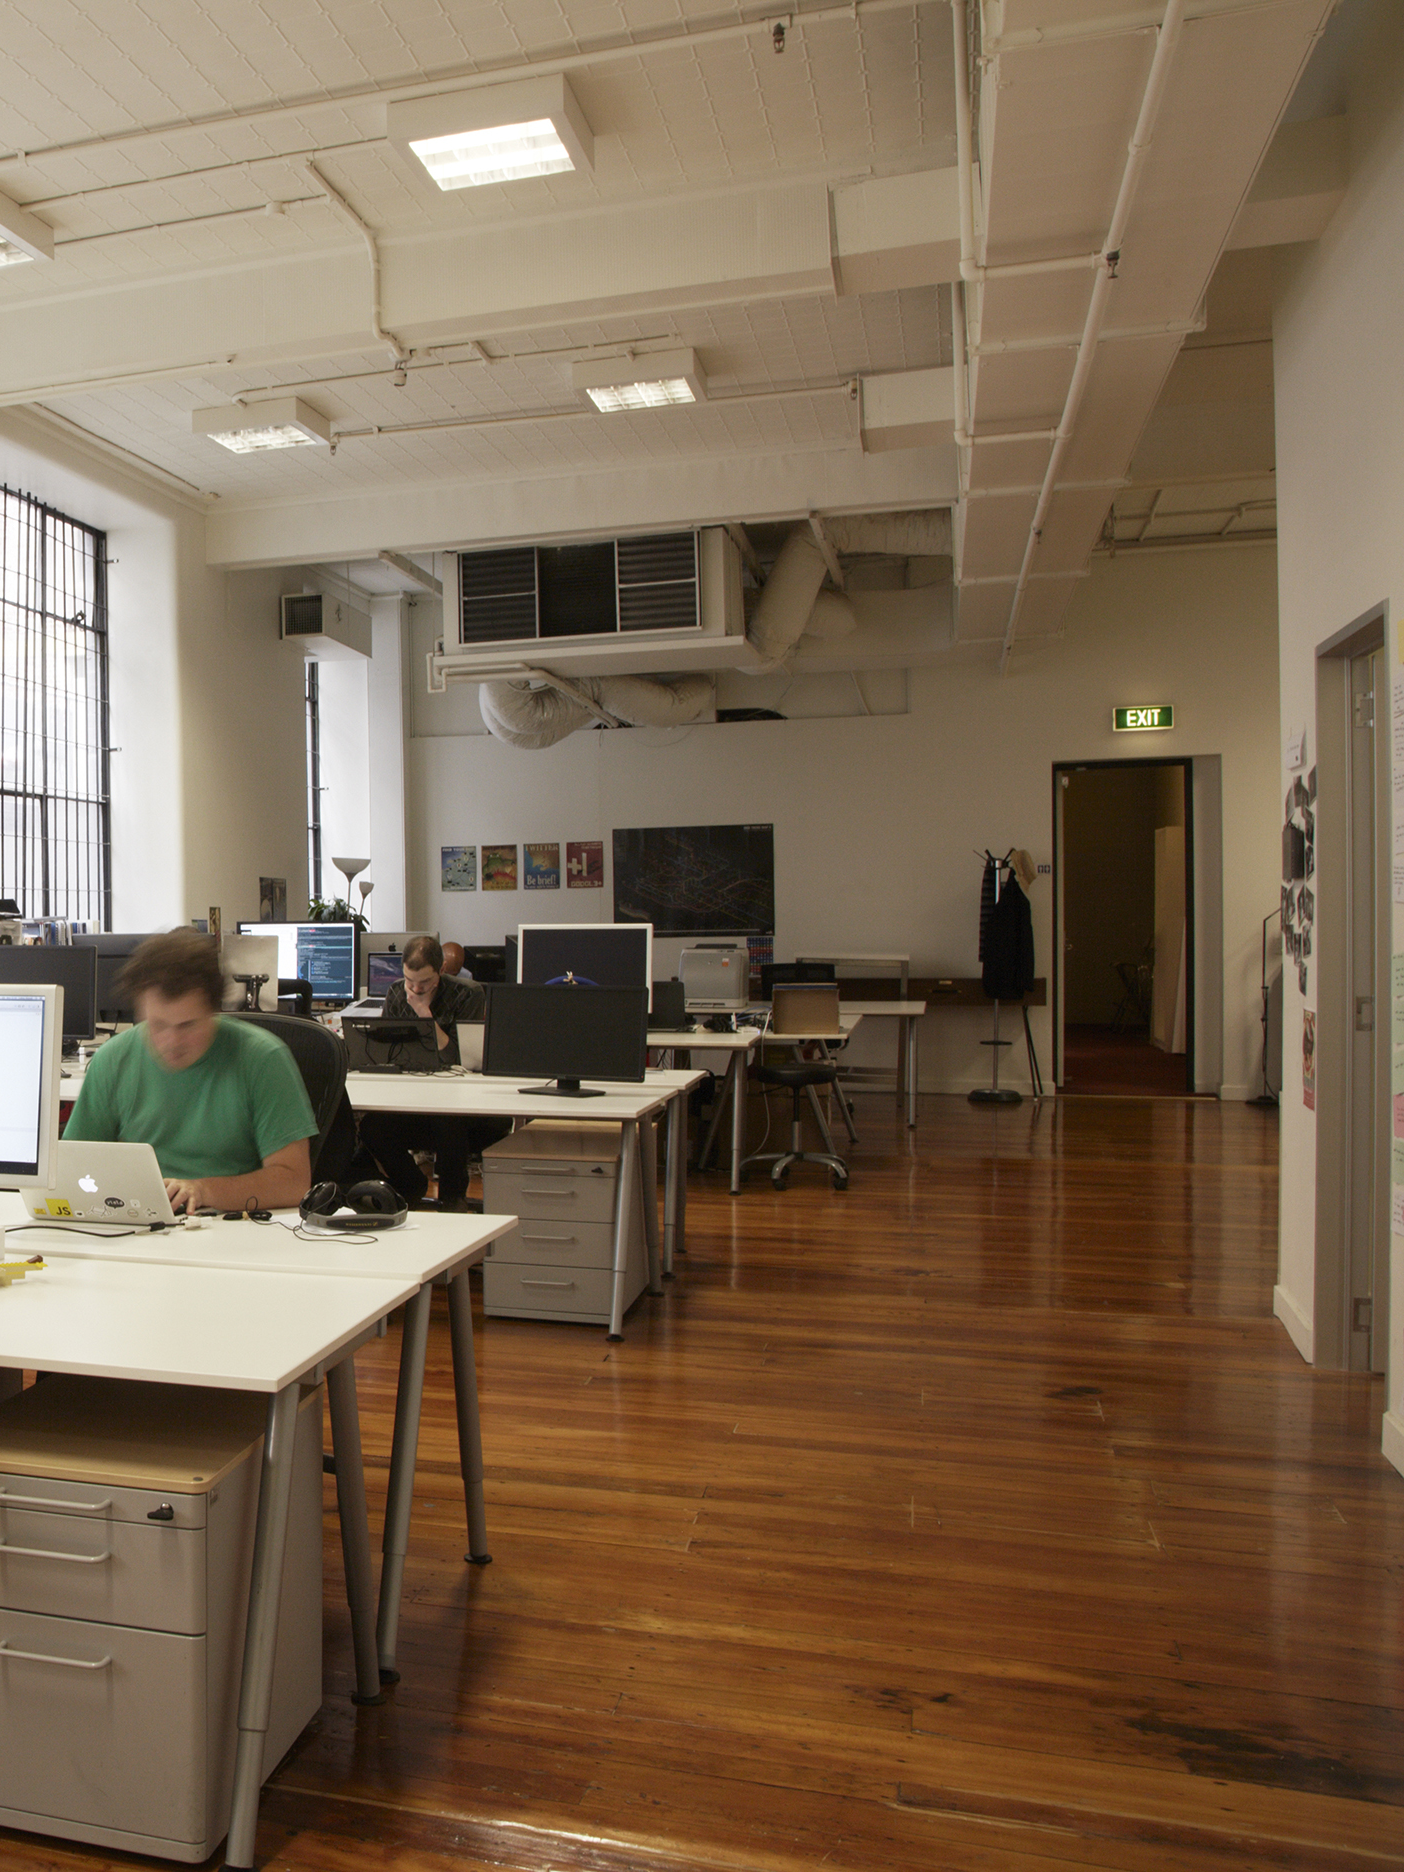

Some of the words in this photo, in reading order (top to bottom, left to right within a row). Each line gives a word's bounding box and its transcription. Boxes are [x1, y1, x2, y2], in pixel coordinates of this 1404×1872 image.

[1126, 708, 1161, 727] EXIT
[526, 874, 536, 885] Be
[537, 874, 556, 885] brief!
[56, 1206, 71, 1216] JS
